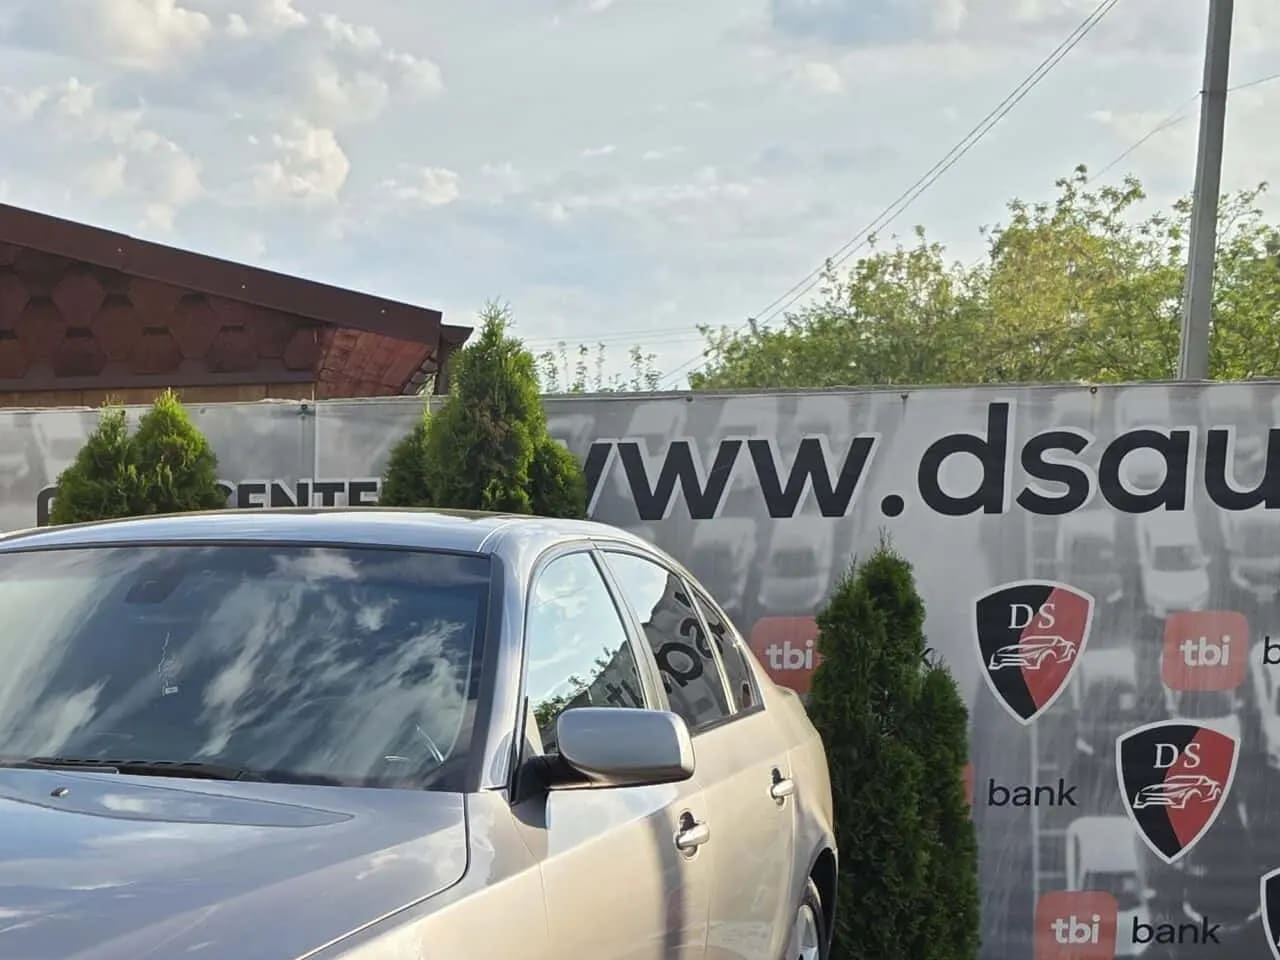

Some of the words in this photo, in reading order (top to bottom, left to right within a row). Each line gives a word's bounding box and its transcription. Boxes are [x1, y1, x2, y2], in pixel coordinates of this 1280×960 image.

[1008, 602, 1056, 630] DS
[765, 638, 814, 671] tbi
[1179, 635, 1231, 667] tbi
[1153, 743, 1201, 769] DS
[988, 778, 1078, 808] bank
[1051, 913, 1100, 944] tbi
[1131, 916, 1220, 945] bank
